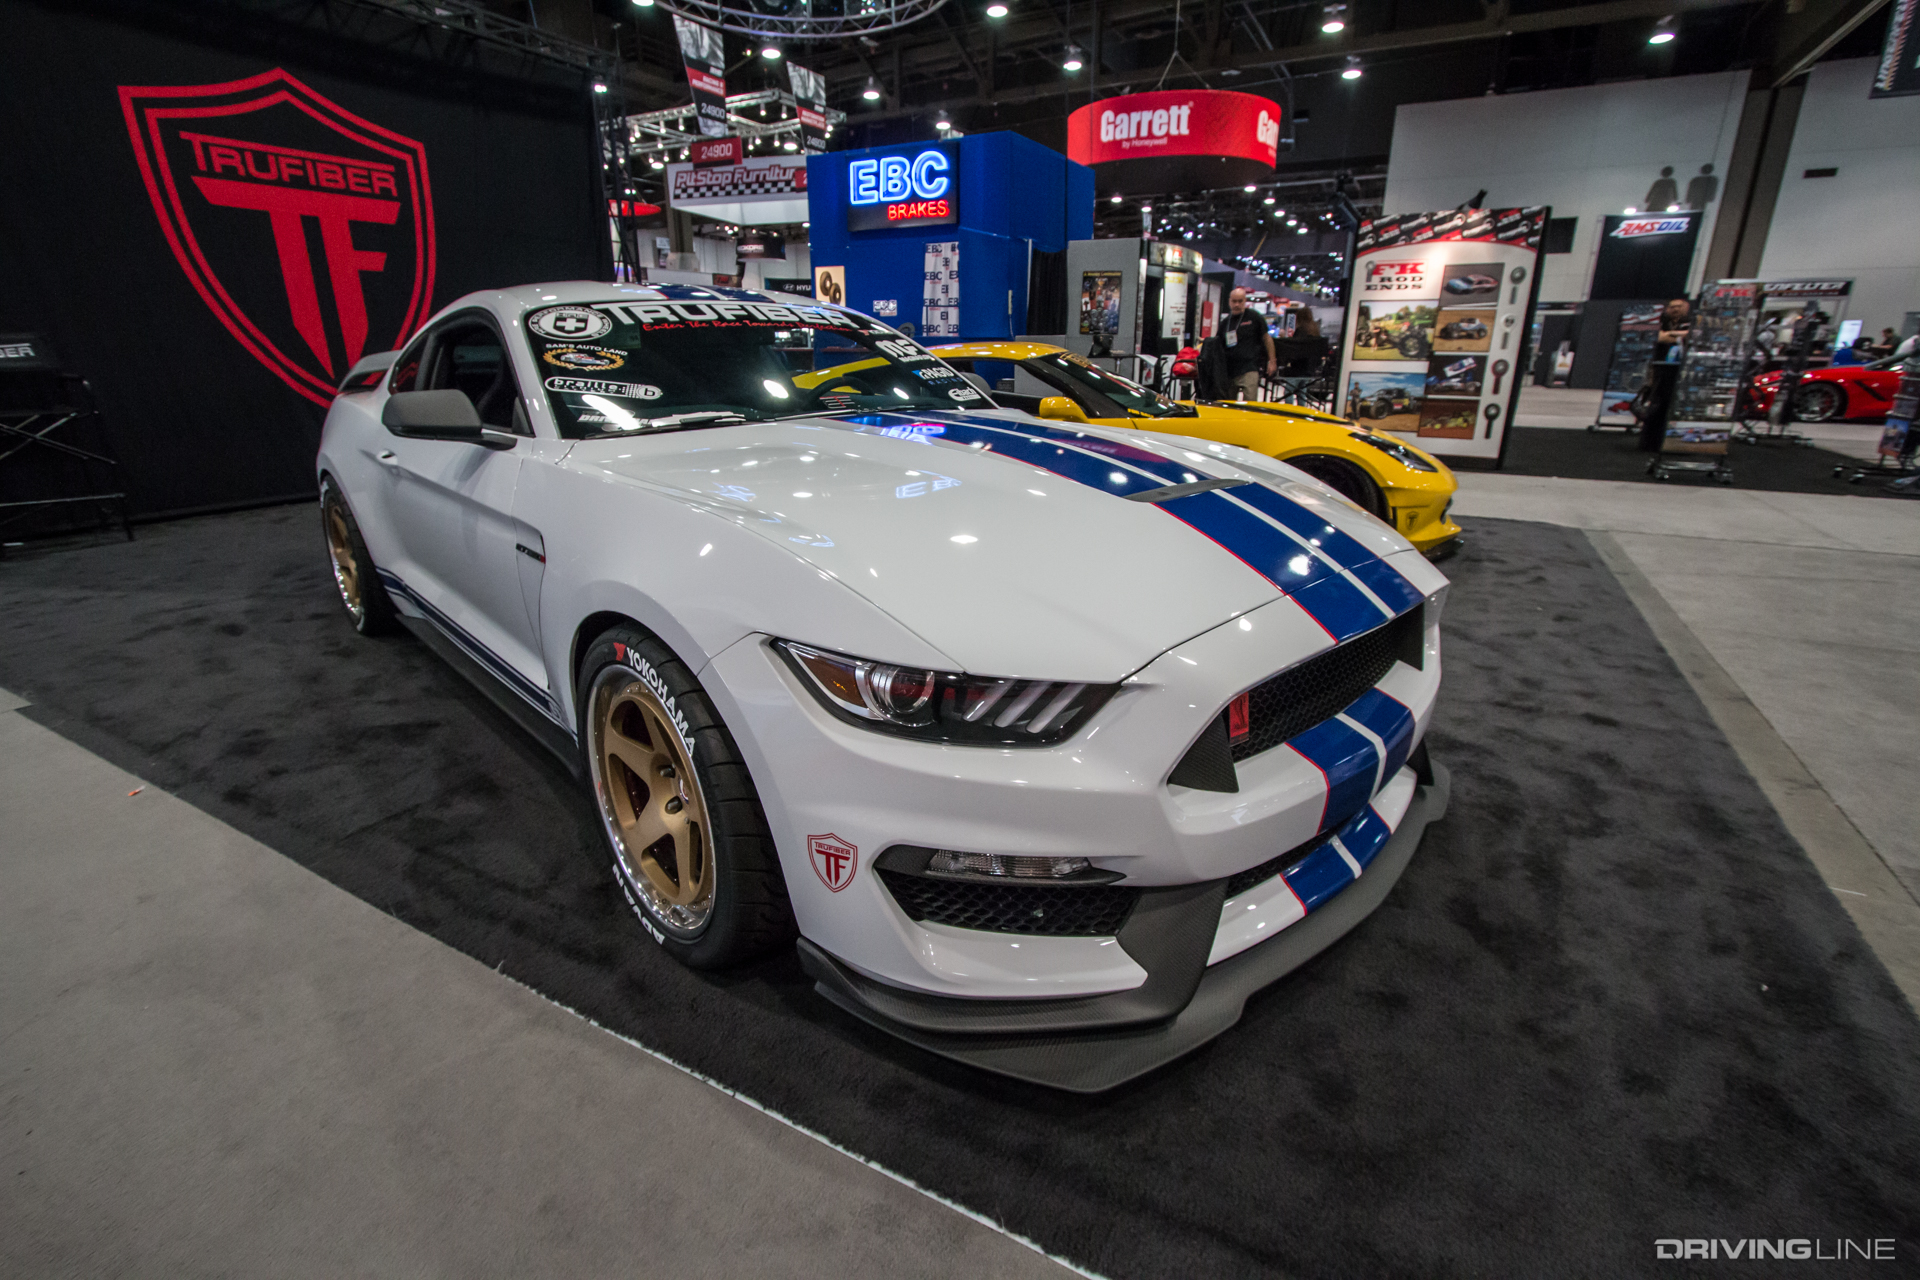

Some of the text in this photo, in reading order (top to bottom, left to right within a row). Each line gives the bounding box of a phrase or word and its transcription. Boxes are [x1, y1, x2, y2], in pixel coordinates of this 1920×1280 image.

[1101, 105, 1191, 143] Garrett
[701, 143, 733, 159] 24900
[179, 131, 398, 198] TRUFIBER
[849, 150, 950, 205] EBC
[887, 199, 950, 221] BRAKES
[1617, 220, 1685, 237] AMSOIL
[191, 175, 402, 380] TF
[1365, 283, 1422, 291] ENDS
[1380, 275, 1423, 283] ROD
[590, 299, 860, 329] TRUFIBER
[576, 344, 603, 352] AUTO
[603, 347, 629, 357] LAND
[553, 378, 618, 391] braille
[626, 646, 696, 758] YOKOHAMA
[814, 841, 851, 856] TRUFIBER
[814, 848, 851, 887] TF
